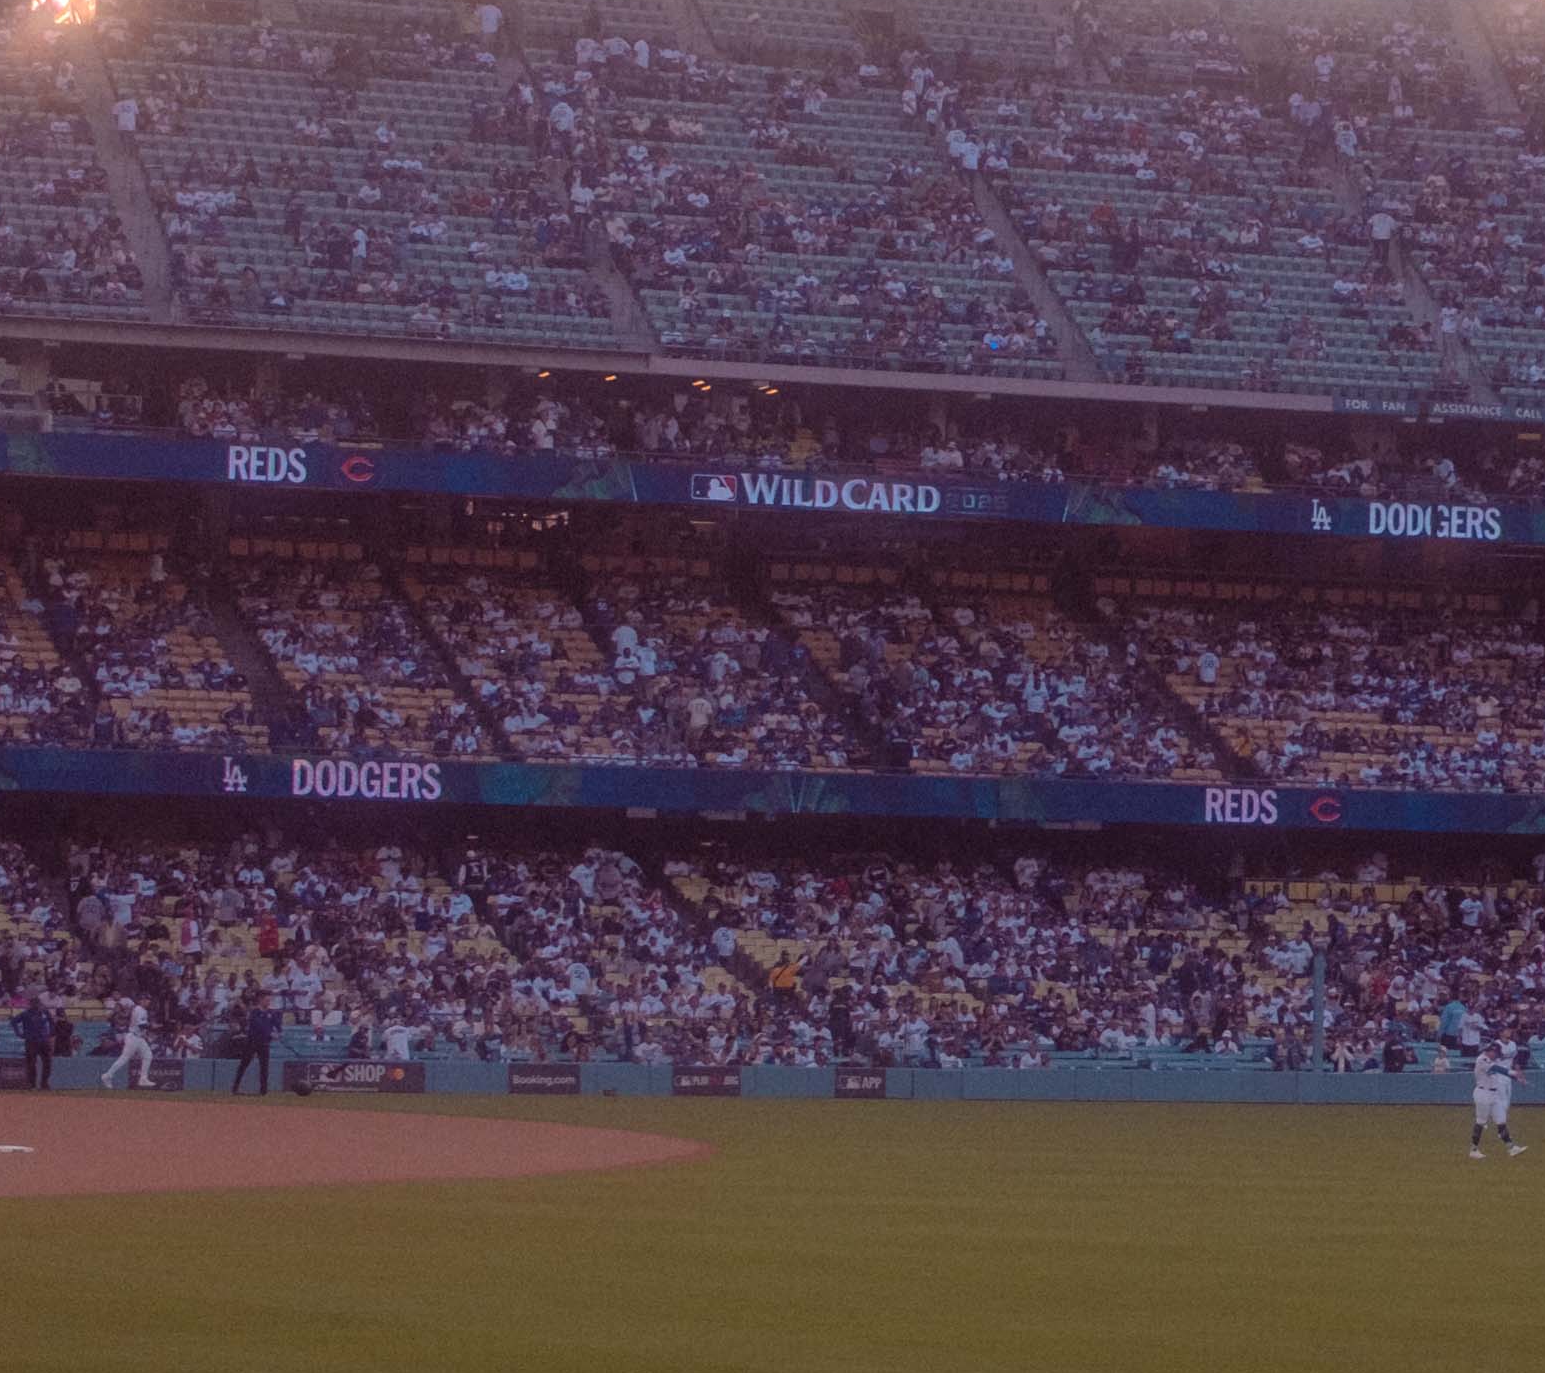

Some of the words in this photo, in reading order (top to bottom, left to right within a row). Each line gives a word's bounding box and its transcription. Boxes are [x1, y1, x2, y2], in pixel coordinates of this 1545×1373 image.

[1344, 399, 1370, 410] FOR
[1383, 401, 1406, 412] FAN
[1432, 403, 1503, 417] ASSISTANCE
[1515, 409, 1542, 420] CALL
[227, 444, 307, 484] REDS
[1368, 501, 1501, 541] DODGERS
[292, 758, 443, 800] DODGERS
[1204, 787, 1279, 825] REDS
[343, 1064, 387, 1083] SHOP
[512, 1074, 576, 1087] Booking.com
[862, 1076, 883, 1089] APP
